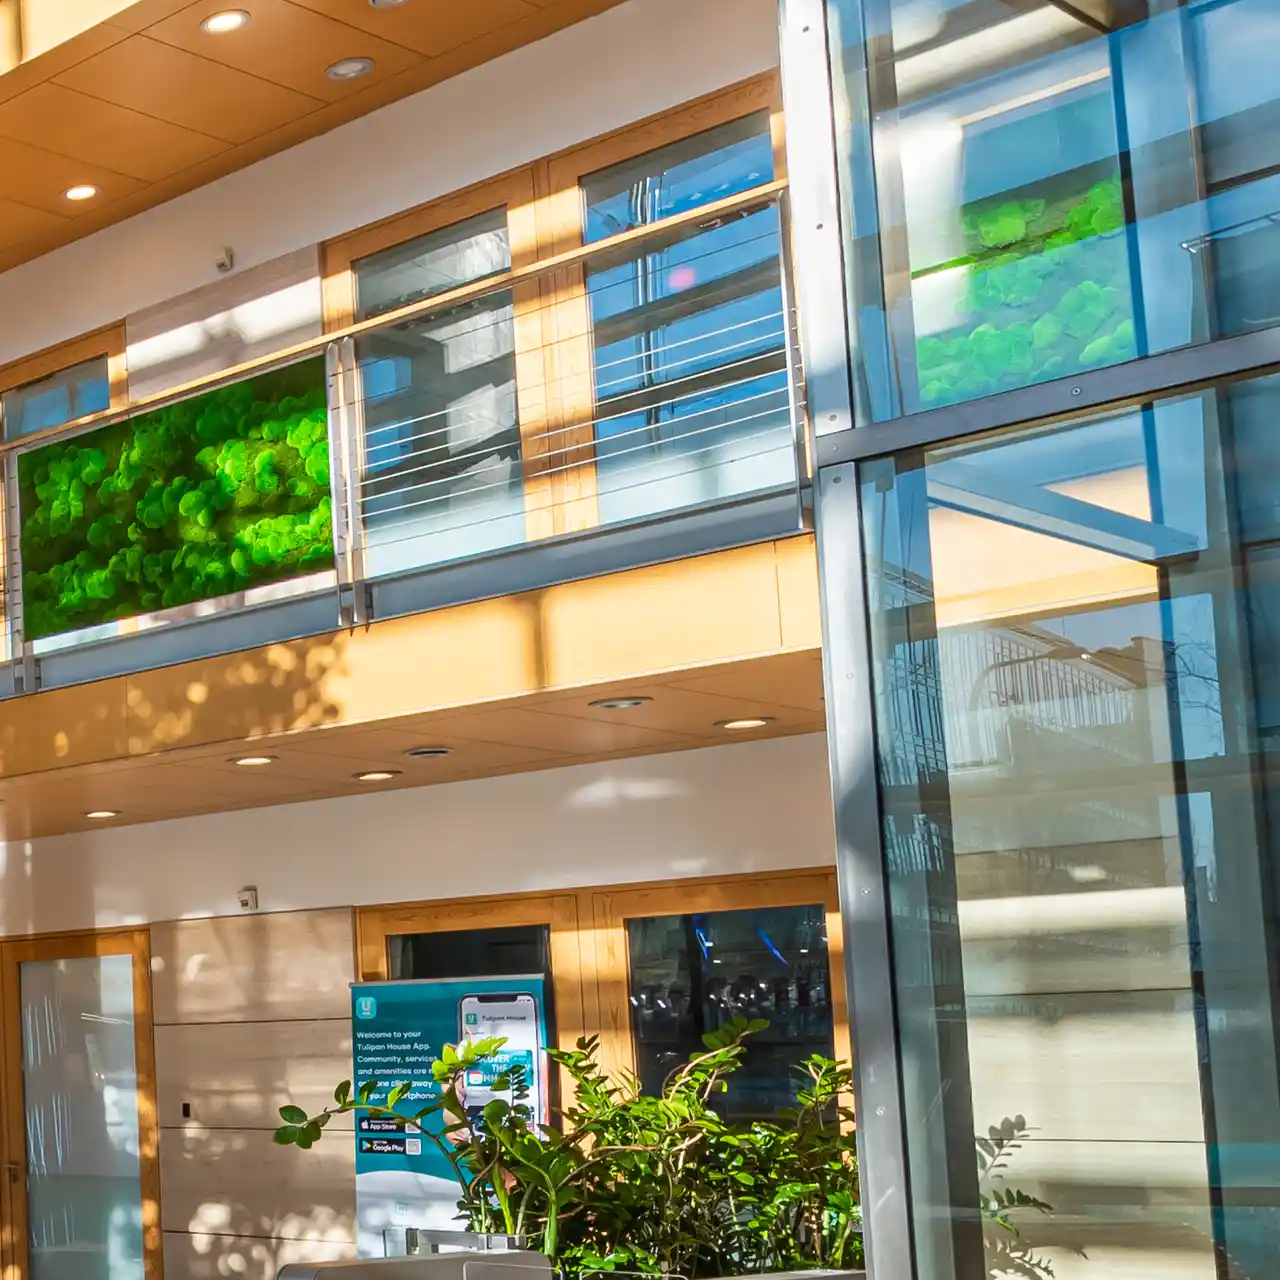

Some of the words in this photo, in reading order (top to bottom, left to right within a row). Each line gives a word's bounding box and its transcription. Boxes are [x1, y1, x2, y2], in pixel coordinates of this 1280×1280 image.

[356, 1031, 392, 1039] Welcome
[402, 1031, 422, 1039] your
[357, 1043, 386, 1051] Tulipan
[357, 1067, 373, 1075] and
[374, 1067, 412, 1075] amenities
[397, 1091, 436, 1101] rtphone
[372, 1144, 392, 1152] Google
[392, 1144, 404, 1152] Play
